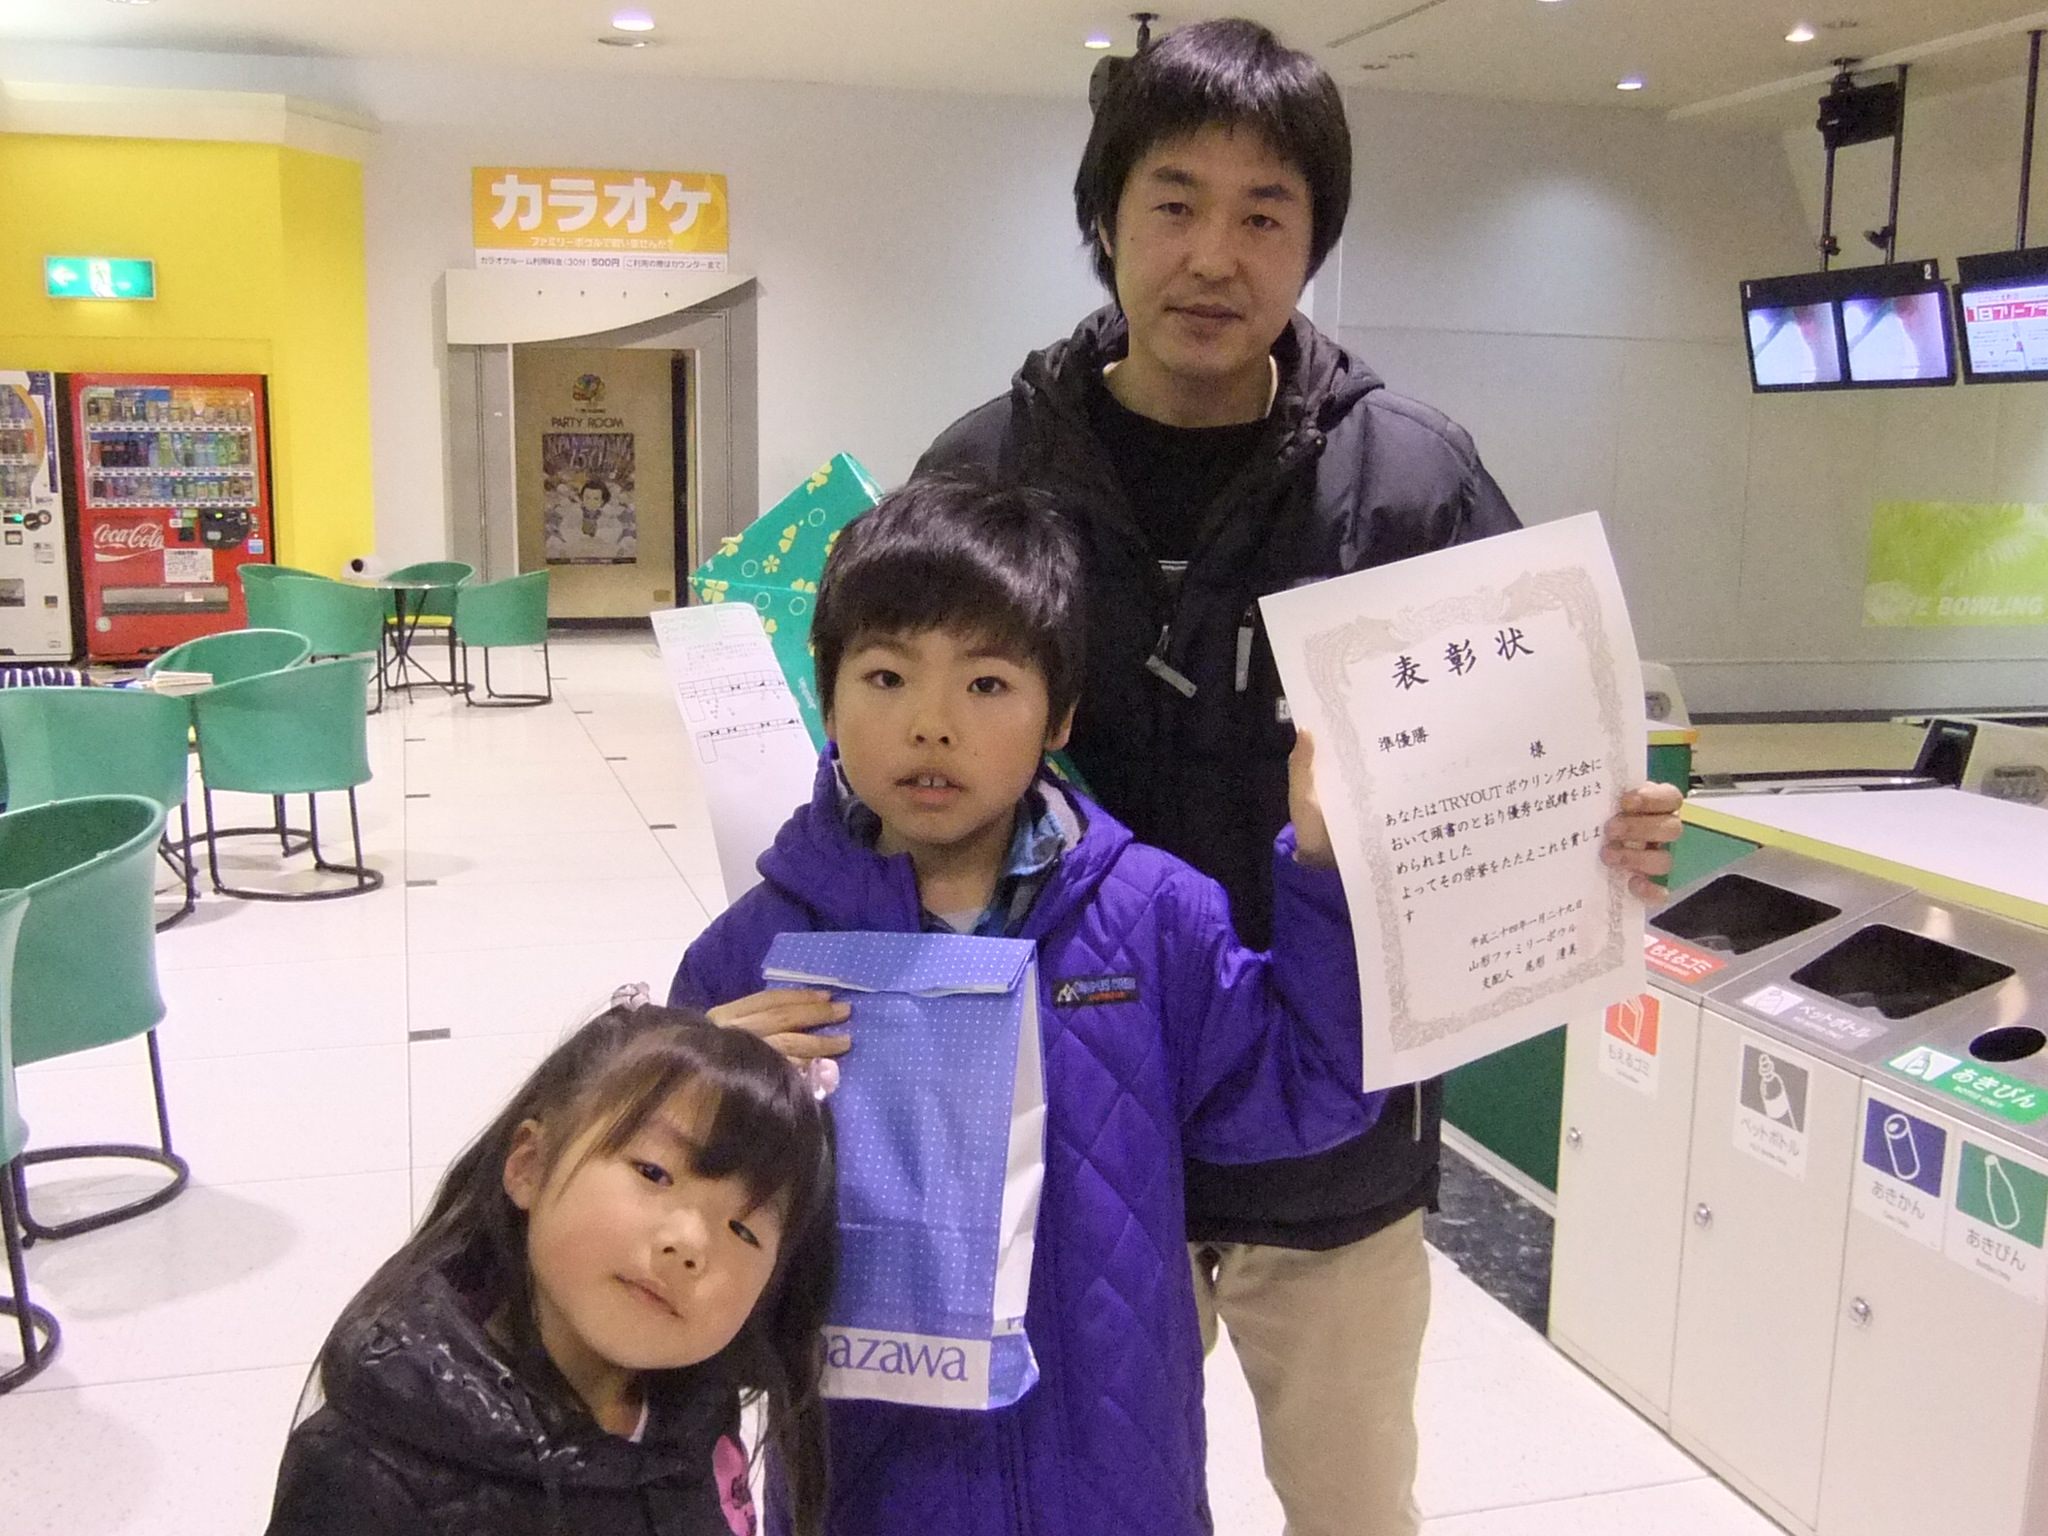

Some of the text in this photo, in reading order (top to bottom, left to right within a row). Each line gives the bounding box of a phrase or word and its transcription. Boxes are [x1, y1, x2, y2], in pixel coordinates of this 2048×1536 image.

[491, 174, 711, 235] カラオケ
[591, 257, 620, 268] 500円
[1924, 264, 1932, 280] 2
[551, 416, 624, 428] PARTY ROOM
[1392, 627, 1534, 691] 表彰状
[1378, 726, 1430, 753] 準優勝
[1529, 740, 1547, 759] 様
[1396, 844, 1473, 876] められました
[1404, 909, 1415, 925] す
[1650, 944, 1713, 974] もえるゴミ
[1951, 1068, 2036, 1109] あきびん
[1871, 1181, 1926, 1220] あきかん
[1965, 1229, 2026, 1272] あきびん
